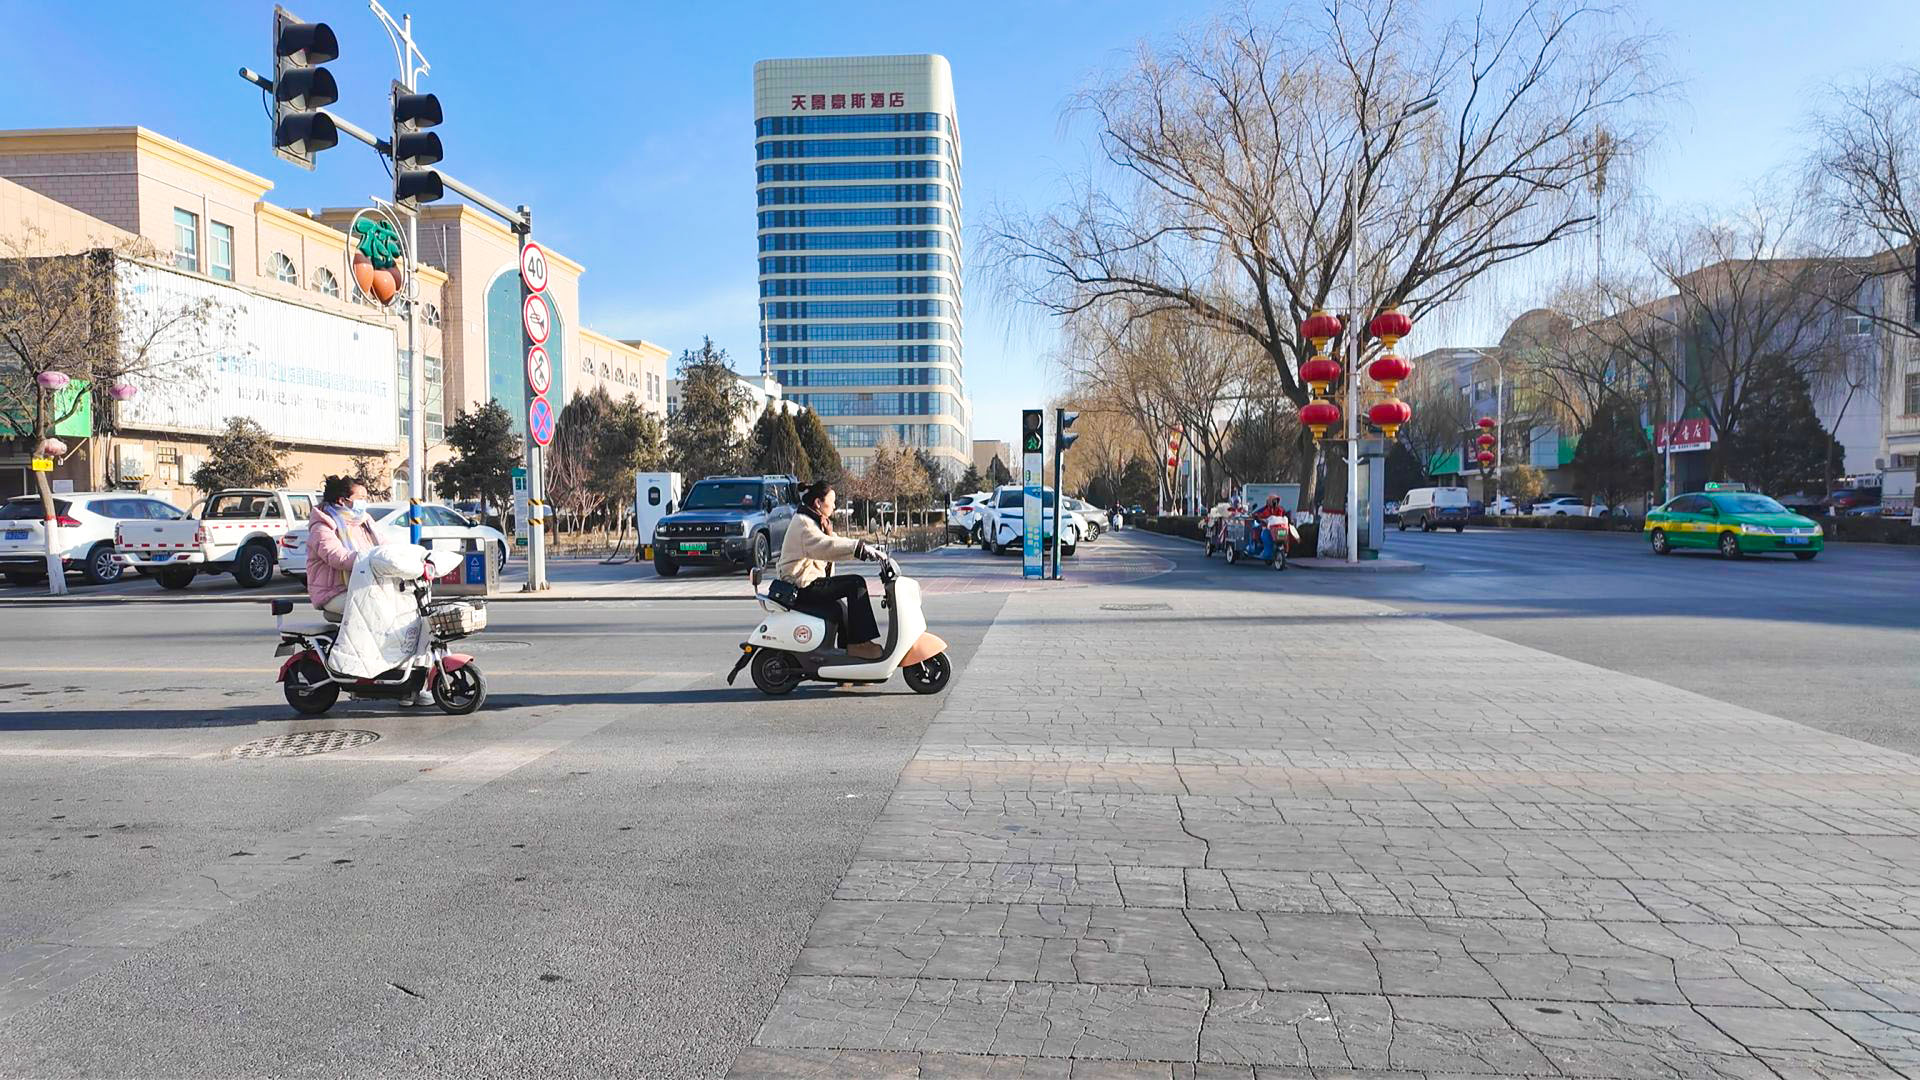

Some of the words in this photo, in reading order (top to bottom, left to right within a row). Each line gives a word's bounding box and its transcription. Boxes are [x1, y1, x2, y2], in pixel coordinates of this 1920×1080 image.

[791, 92, 905, 111] 天景豪斯酒店
[528, 256, 544, 280] 40
